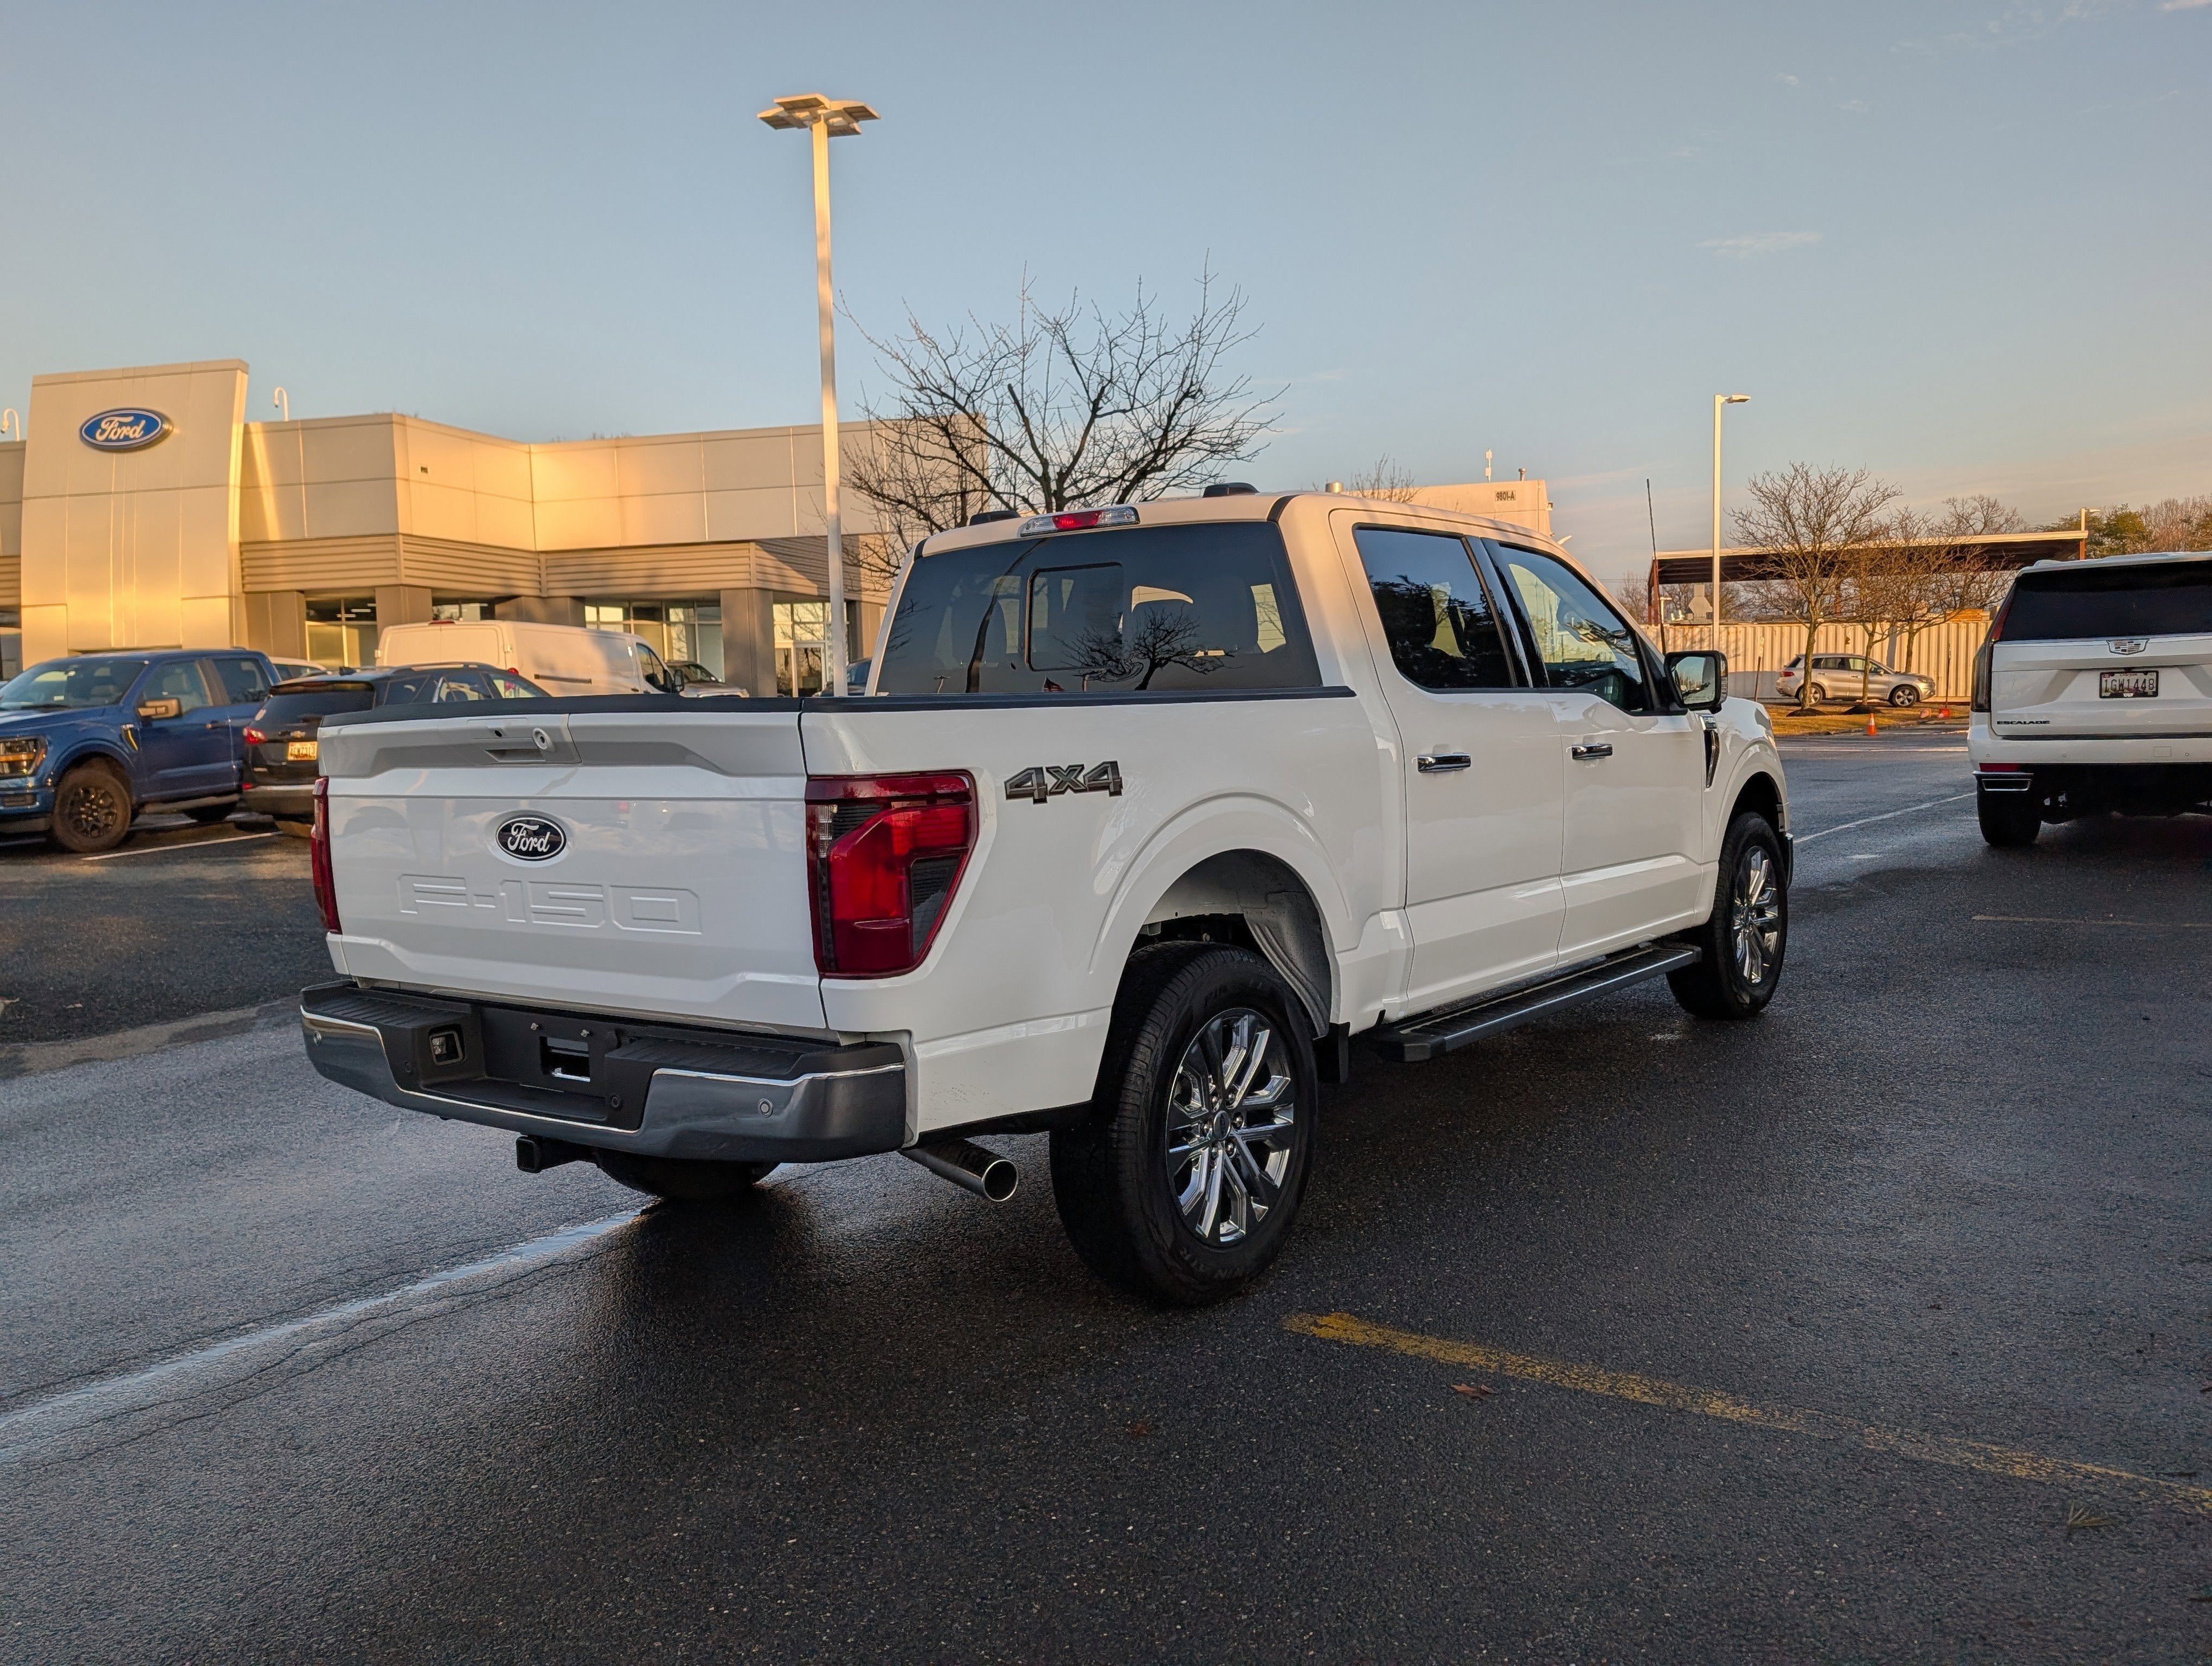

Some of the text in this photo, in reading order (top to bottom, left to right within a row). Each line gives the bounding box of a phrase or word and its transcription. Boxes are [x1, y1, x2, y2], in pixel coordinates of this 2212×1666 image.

[95, 416, 144, 441] Ford
[1496, 491, 1515, 501] 9801-A
[2105, 678, 2155, 693] 1GW1448
[507, 823, 551, 853] Ford
[397, 874, 702, 935] F-150
